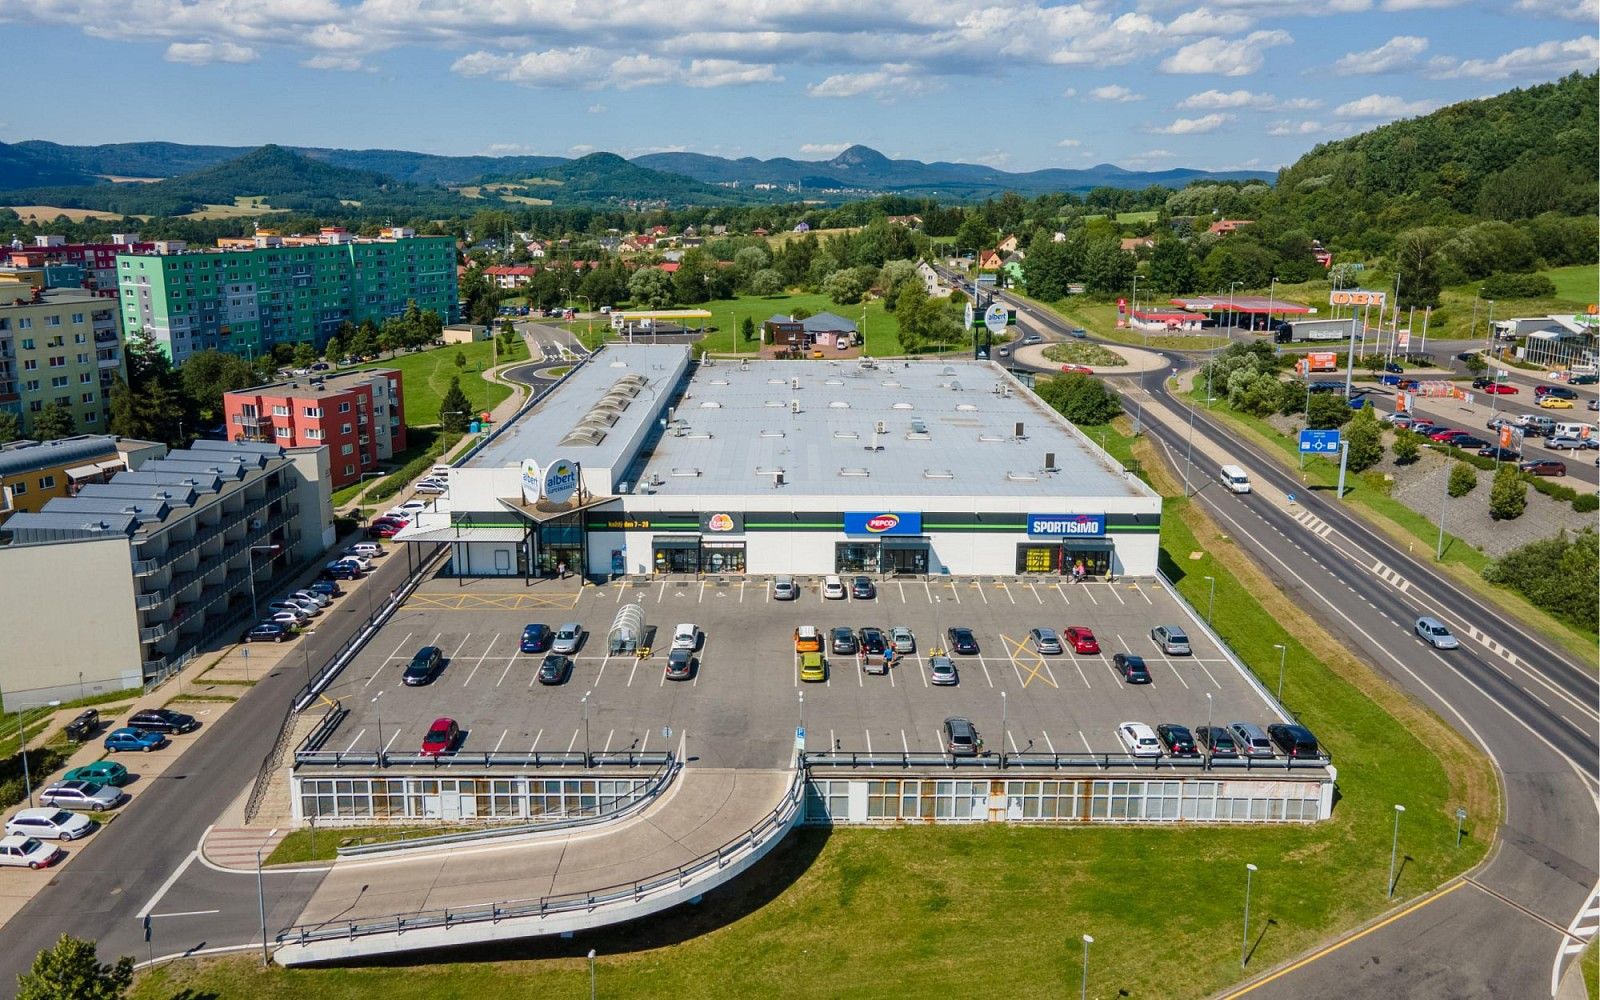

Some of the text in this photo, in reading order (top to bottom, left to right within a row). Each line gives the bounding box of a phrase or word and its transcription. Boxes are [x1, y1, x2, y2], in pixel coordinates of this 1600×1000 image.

[1333, 293, 1383, 305] OBI
[547, 471, 575, 487] albert
[1033, 521, 1098, 533] SPORTISIMO
